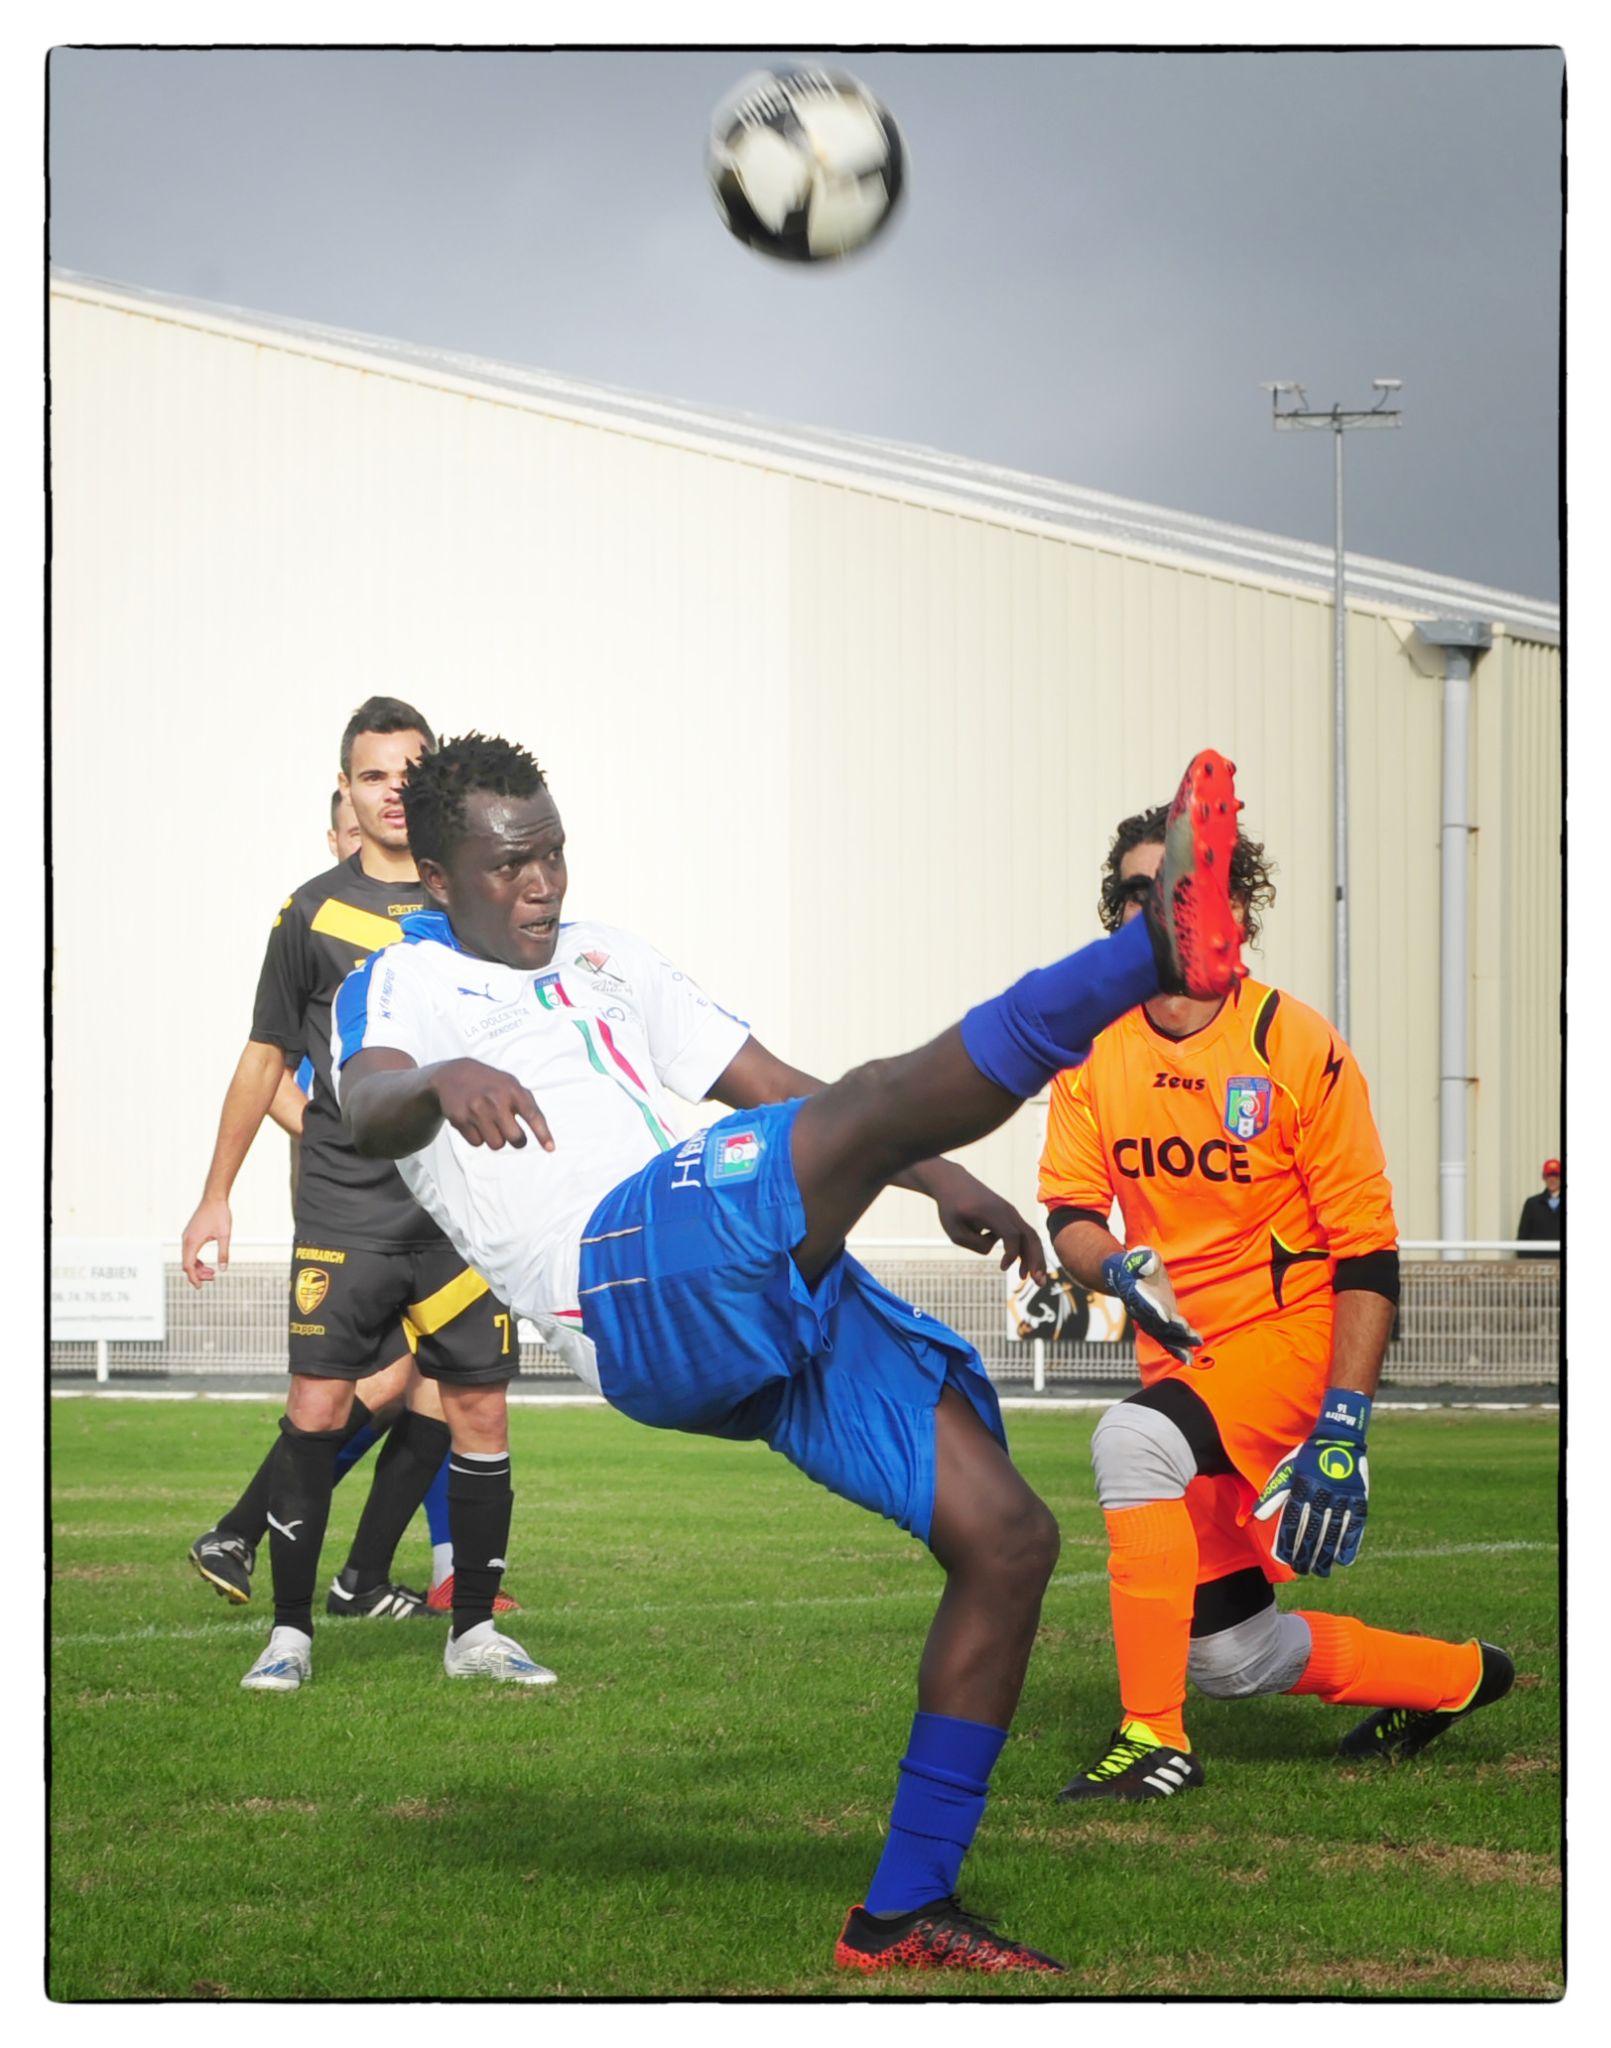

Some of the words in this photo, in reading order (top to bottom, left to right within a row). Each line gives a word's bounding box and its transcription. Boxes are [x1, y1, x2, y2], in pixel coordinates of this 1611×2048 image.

[1153, 1072, 1205, 1090] Zeus
[1112, 1136, 1252, 1184] CIOCE
[295, 1247, 346, 1265] PENMARCH
[90, 1266, 138, 1280] FABIEN
[494, 1313, 510, 1355] 7
